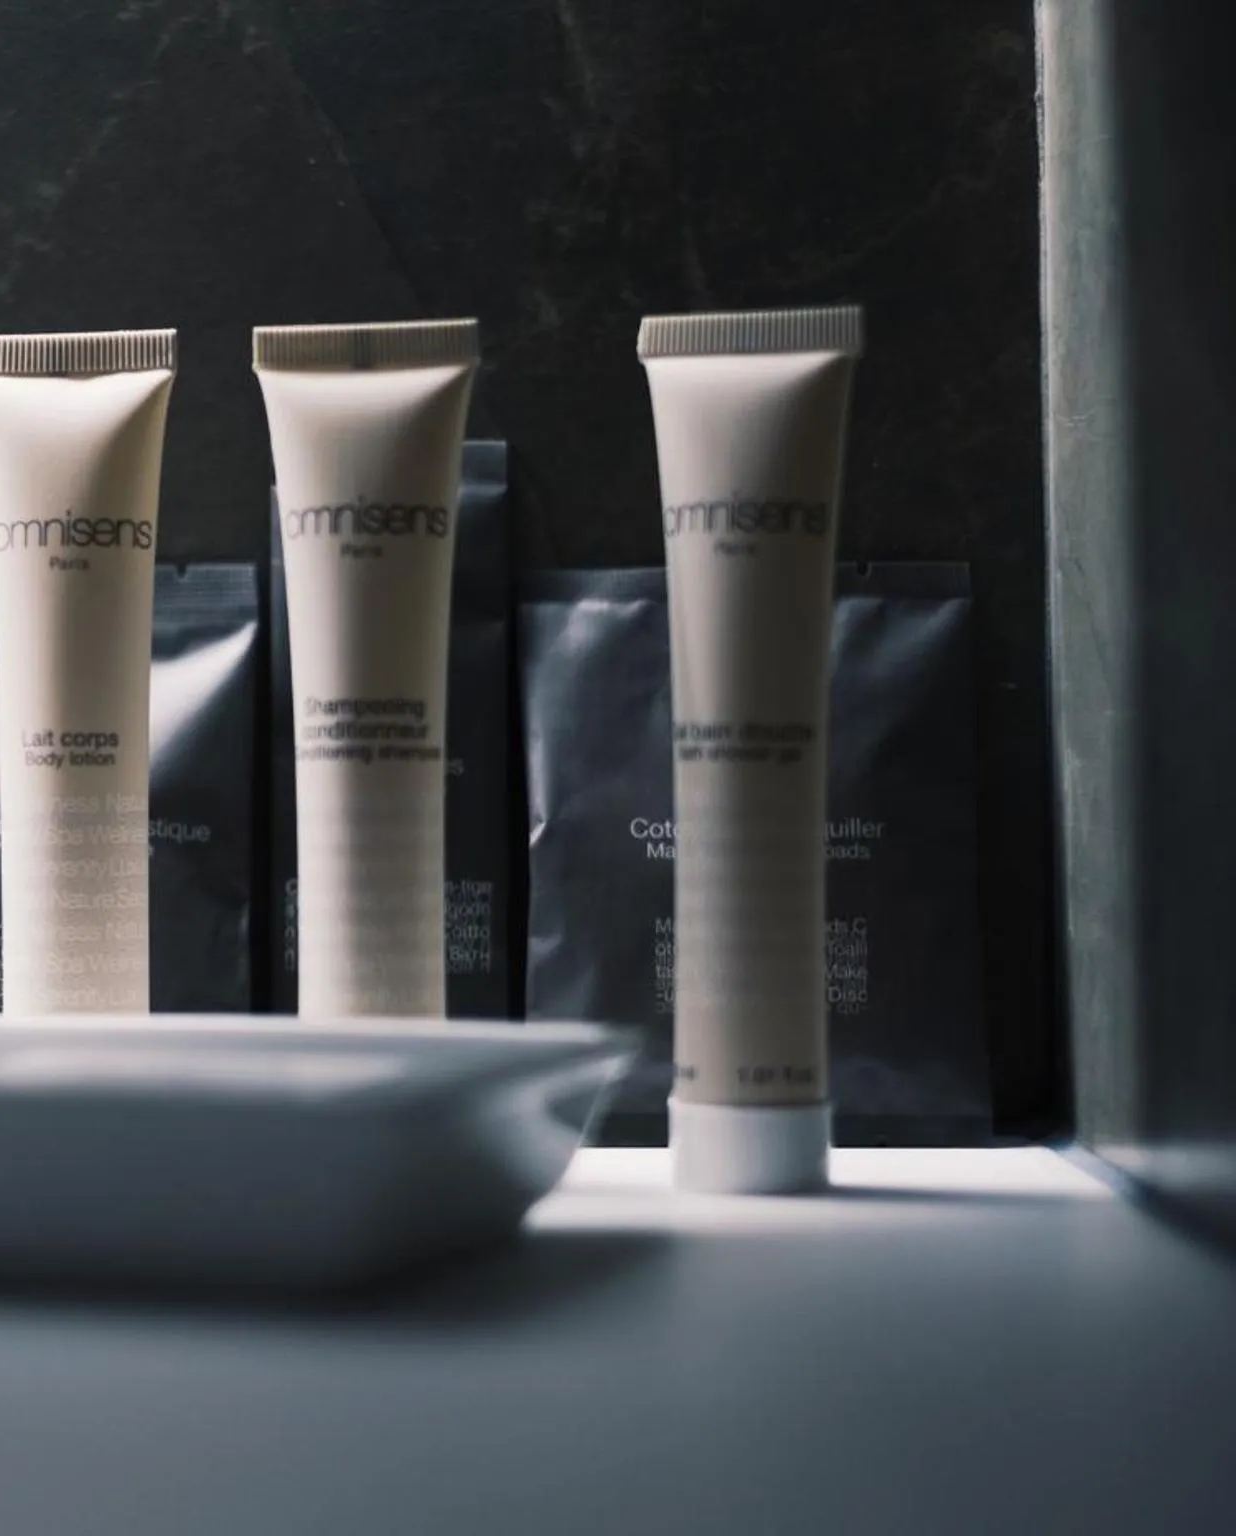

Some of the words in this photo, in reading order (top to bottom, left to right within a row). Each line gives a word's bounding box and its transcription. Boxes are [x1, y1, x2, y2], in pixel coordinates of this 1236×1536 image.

[286, 495, 448, 539] omnisens
[666, 490, 827, 537] omnisens
[49, 554, 91, 570] Paris
[21, 728, 54, 748] Lait
[60, 731, 119, 750] corps
[25, 751, 64, 771] Body
[68, 751, 116, 767] lotion
